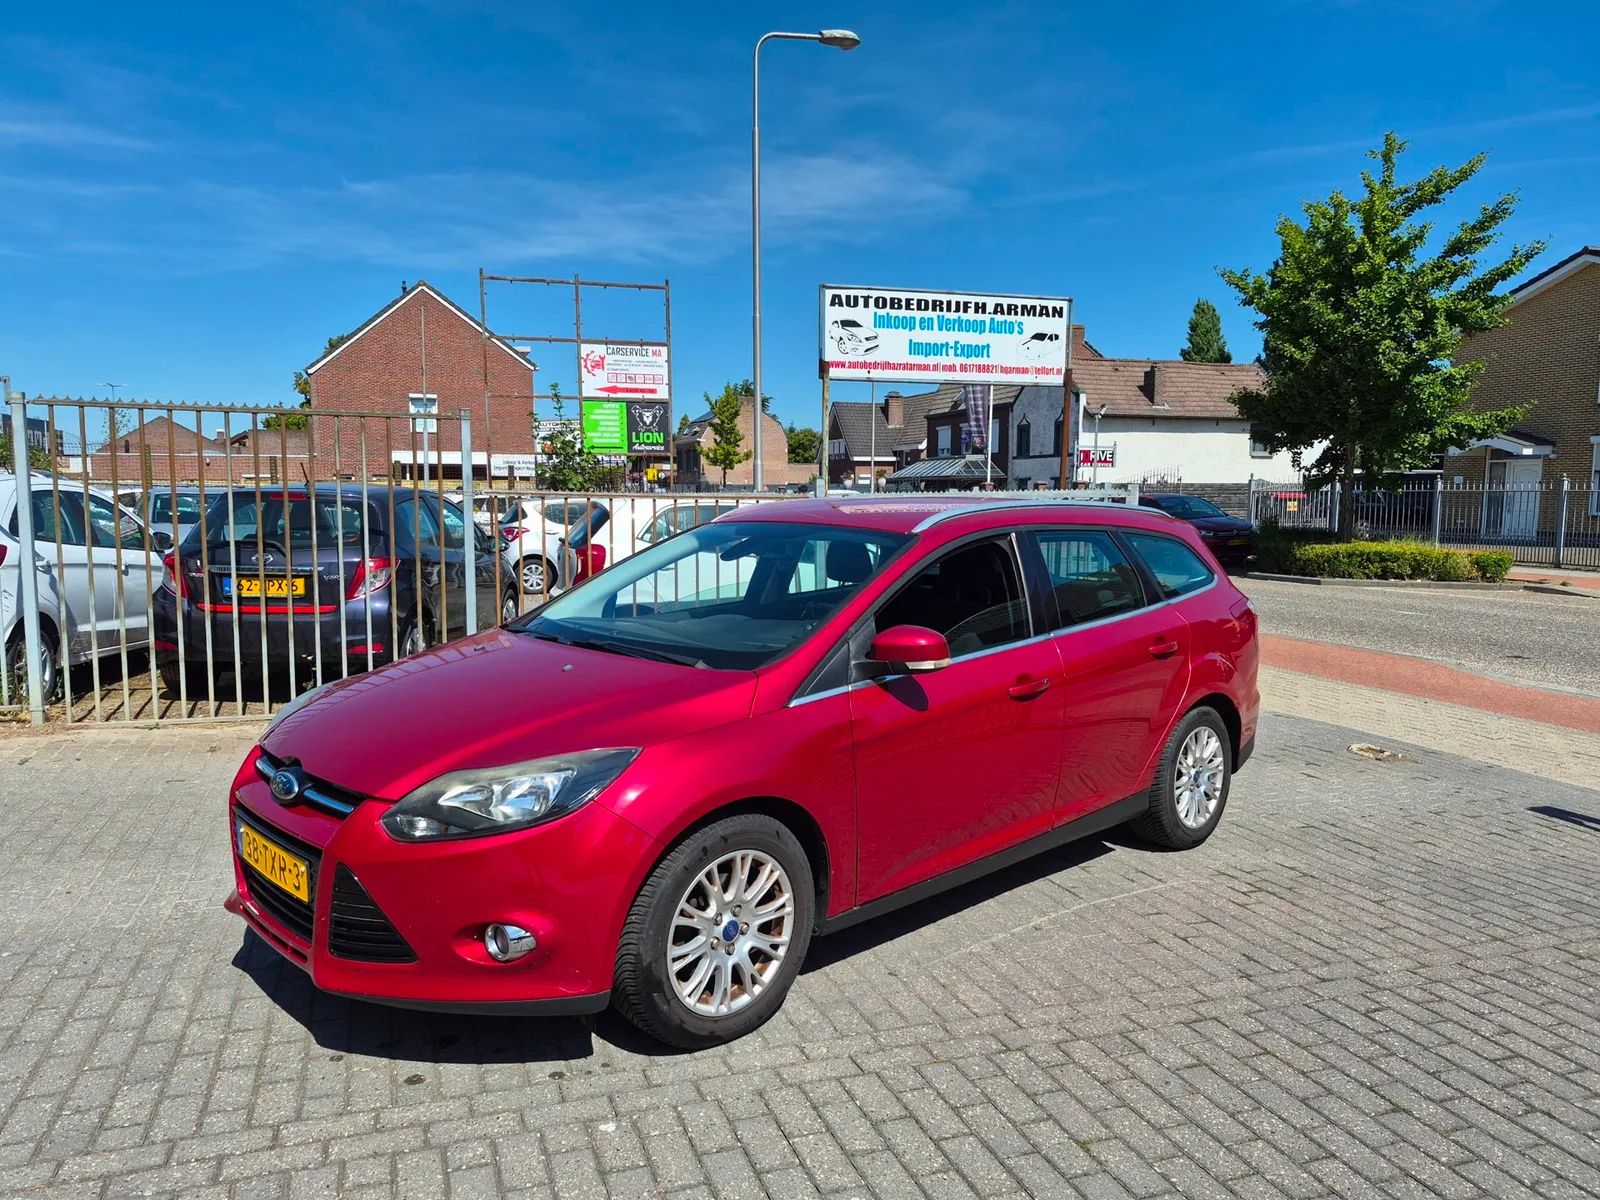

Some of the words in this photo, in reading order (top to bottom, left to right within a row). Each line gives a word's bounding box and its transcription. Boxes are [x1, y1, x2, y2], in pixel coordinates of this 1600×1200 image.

[873, 311, 916, 332] Inkoop
[919, 316, 934, 331] en
[937, 314, 986, 335] Verkoop
[988, 317, 1024, 335] Auto's
[606, 346, 650, 357] CARSERVICE
[651, 348, 662, 357] MA
[908, 338, 991, 359] Import-Export
[632, 431, 664, 443] LION
[237, 579, 299, 592] 62-PX-6
[245, 831, 301, 892] 38-TXR-3
